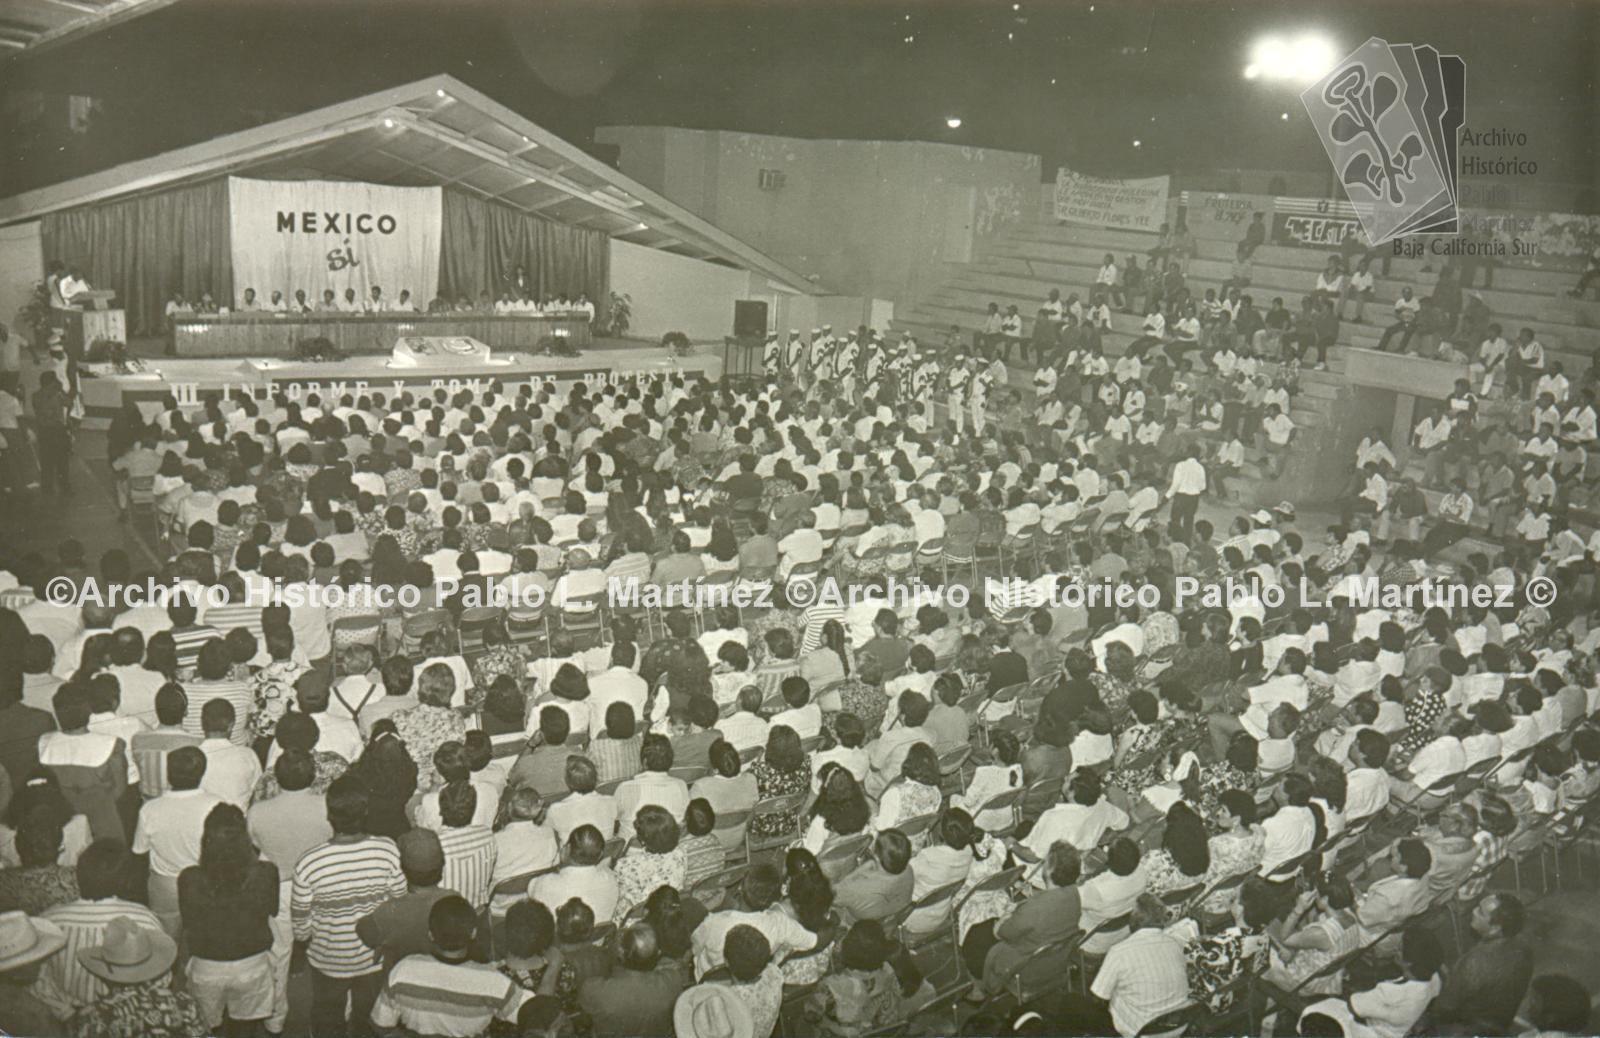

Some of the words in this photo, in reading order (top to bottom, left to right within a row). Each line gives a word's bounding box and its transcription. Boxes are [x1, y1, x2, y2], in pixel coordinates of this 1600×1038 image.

[276, 211, 398, 235] MEXICO
[223, 381, 369, 401] INFORME
[393, 380, 405, 398] Y
[431, 377, 496, 394] TOM
